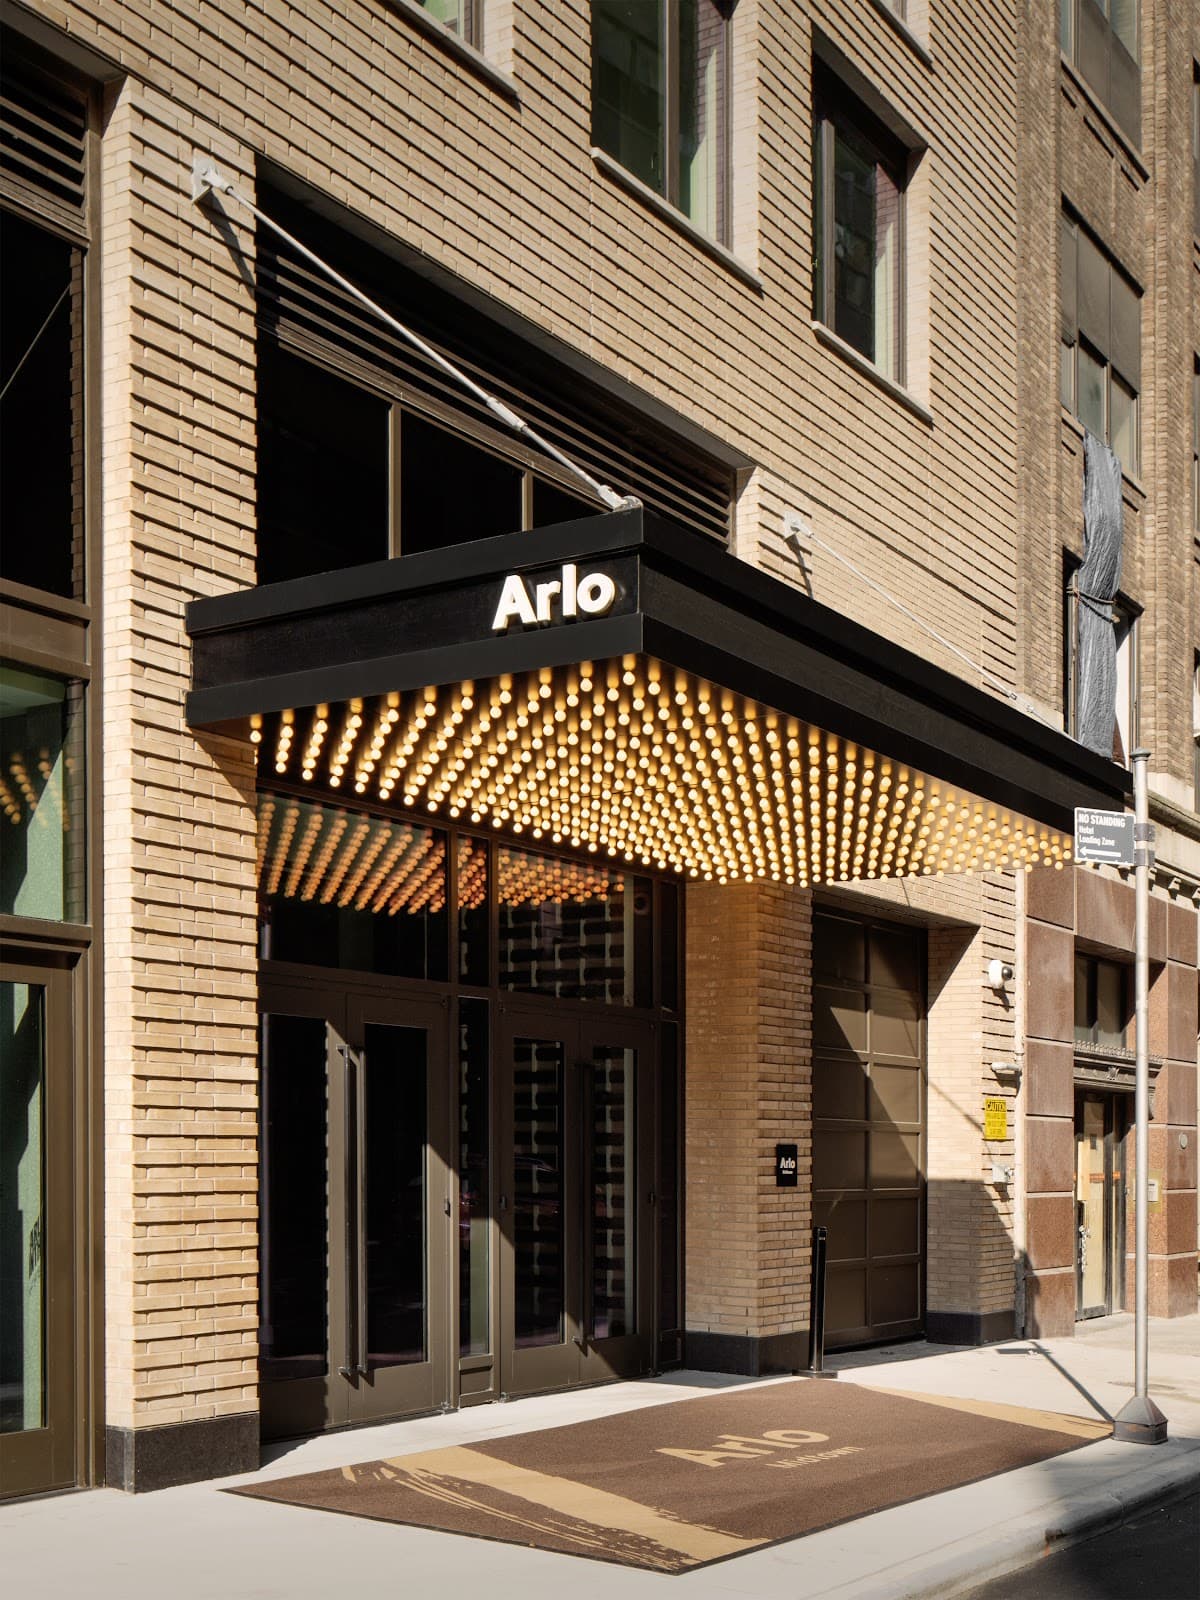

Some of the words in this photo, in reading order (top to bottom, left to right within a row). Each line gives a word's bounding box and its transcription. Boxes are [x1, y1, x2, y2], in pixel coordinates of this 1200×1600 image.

[491, 563, 616, 631] Arlo
[1078, 813, 1090, 824] NO
[1090, 815, 1126, 828] STANDING
[1079, 834, 1101, 846] Loading
[1101, 836, 1116, 847] Zone
[779, 1157, 795, 1168] Arlo
[654, 1429, 830, 1468] Arlo
